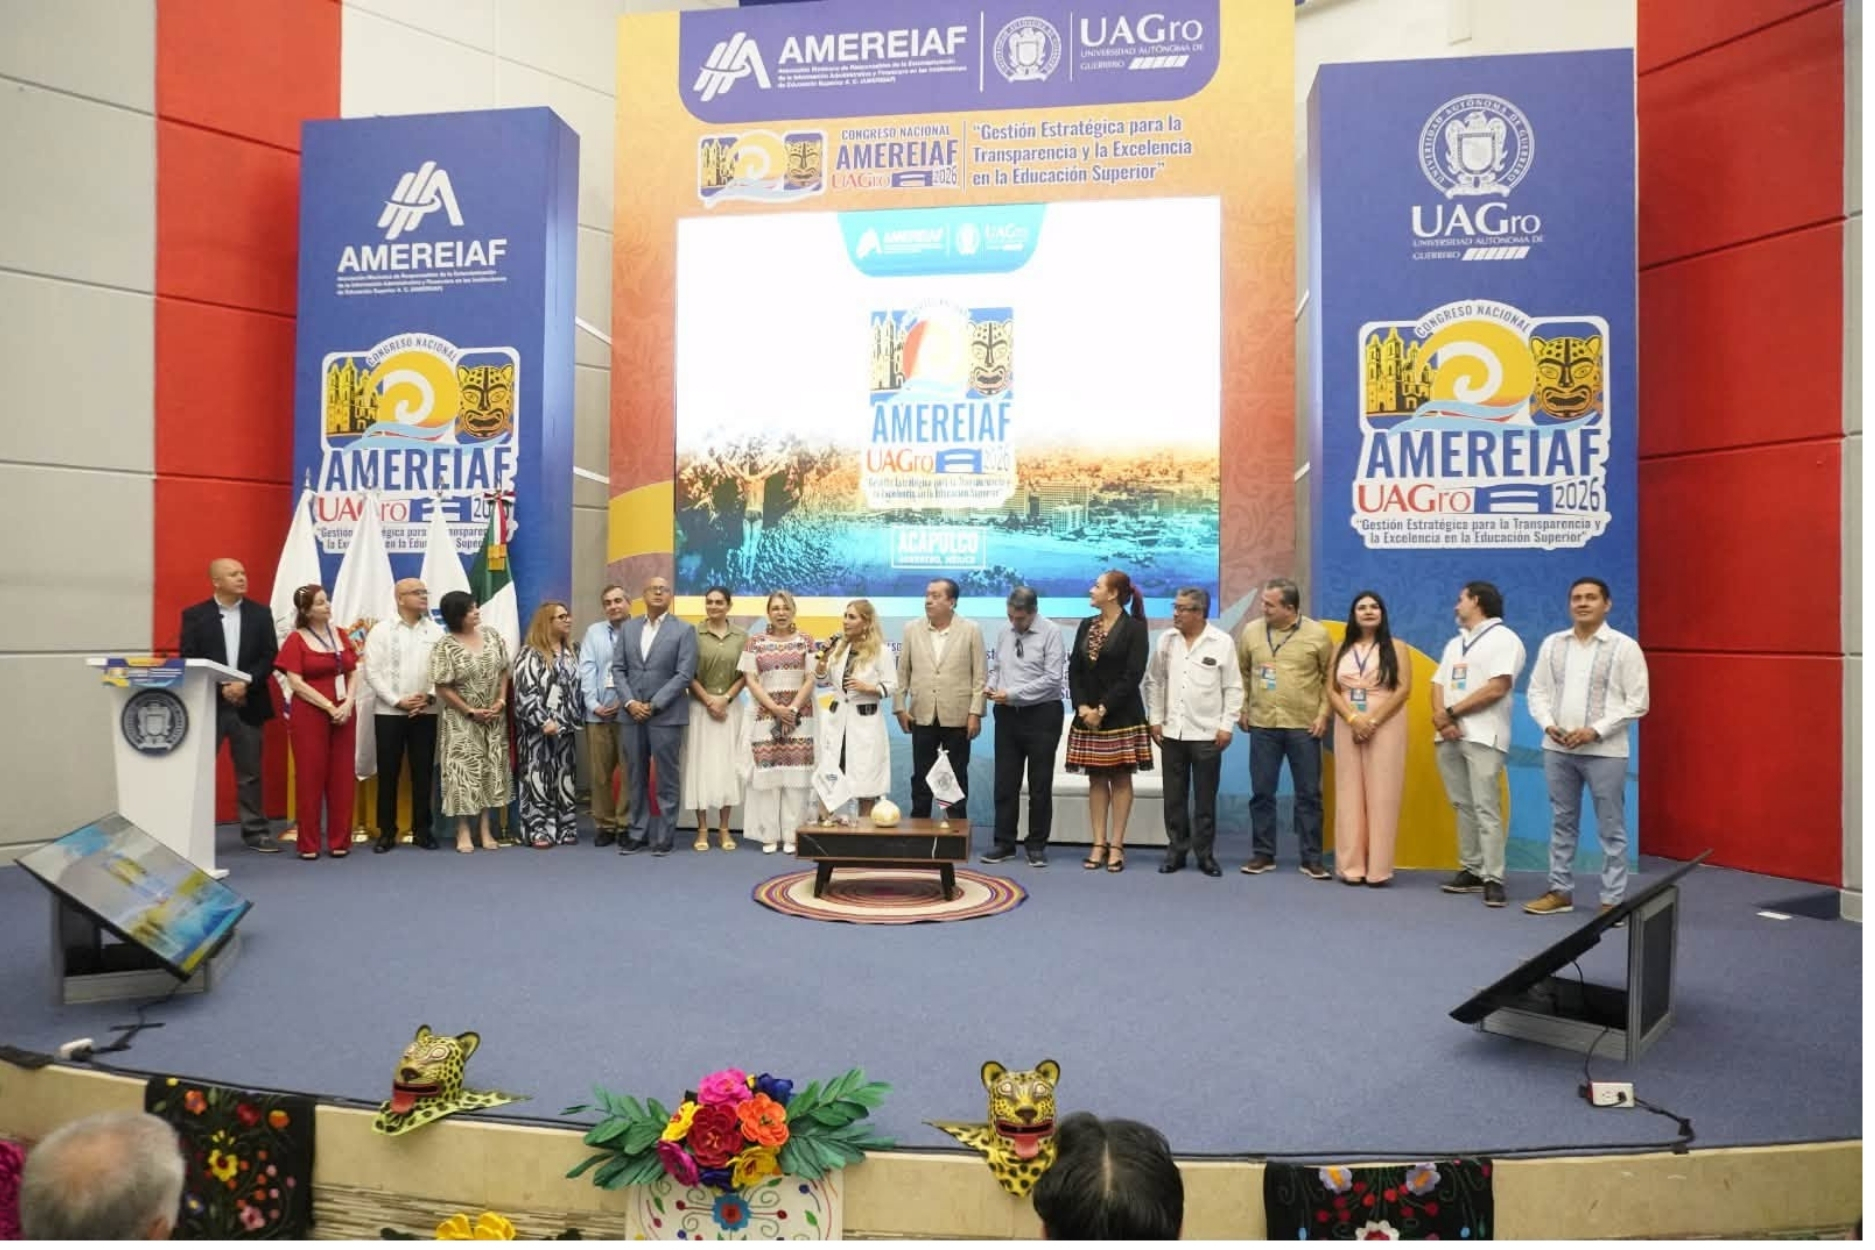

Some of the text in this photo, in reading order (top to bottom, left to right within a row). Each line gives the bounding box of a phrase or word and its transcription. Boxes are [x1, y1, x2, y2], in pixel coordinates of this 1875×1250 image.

[778, 26, 968, 64] AMEREIAF
[1080, 14, 1203, 47] UAGro
[841, 125, 950, 140] CONGRESO NACIONAL
[1041, 118, 1125, 138] Estratégica
[1129, 119, 1164, 134] para
[1168, 115, 1182, 131] la
[836, 139, 959, 170] AMEREIAF
[973, 139, 1192, 163] Transparencia y la Excelencia
[831, 167, 958, 189] UAGro 2026
[973, 173, 990, 186] en
[995, 168, 1008, 185] la
[1013, 165, 1087, 184] Educación
[1411, 202, 1541, 237] UAGro
[337, 239, 508, 273] AMEREIAF
[1413, 237, 1473, 247] UNIVERSIDAD
[1532, 235, 1544, 243] DE
[1413, 251, 1461, 260] GUERRERO
[1416, 305, 1530, 337] CONGRESO NACIONAL
[367, 336, 458, 366] CONGRESO NACIONAL
[872, 402, 1011, 443] AMEREIAF
[866, 449, 933, 473] UAGro
[1366, 429, 1602, 478] AMEREIAF
[325, 447, 512, 491] AMEREIAF
[1358, 477, 1600, 513] UAGro 2026
[1370, 532, 1380, 544] la
[1384, 531, 1441, 544] Excelencia
[1444, 534, 1457, 543] en
[1460, 532, 1470, 543] la
[1474, 530, 1531, 543] Educación
[1406, 518, 1468, 532] Estratégica
[1472, 520, 1496, 532] para
[1500, 518, 1509, 530] la
[1513, 518, 1591, 532] Transparencia
